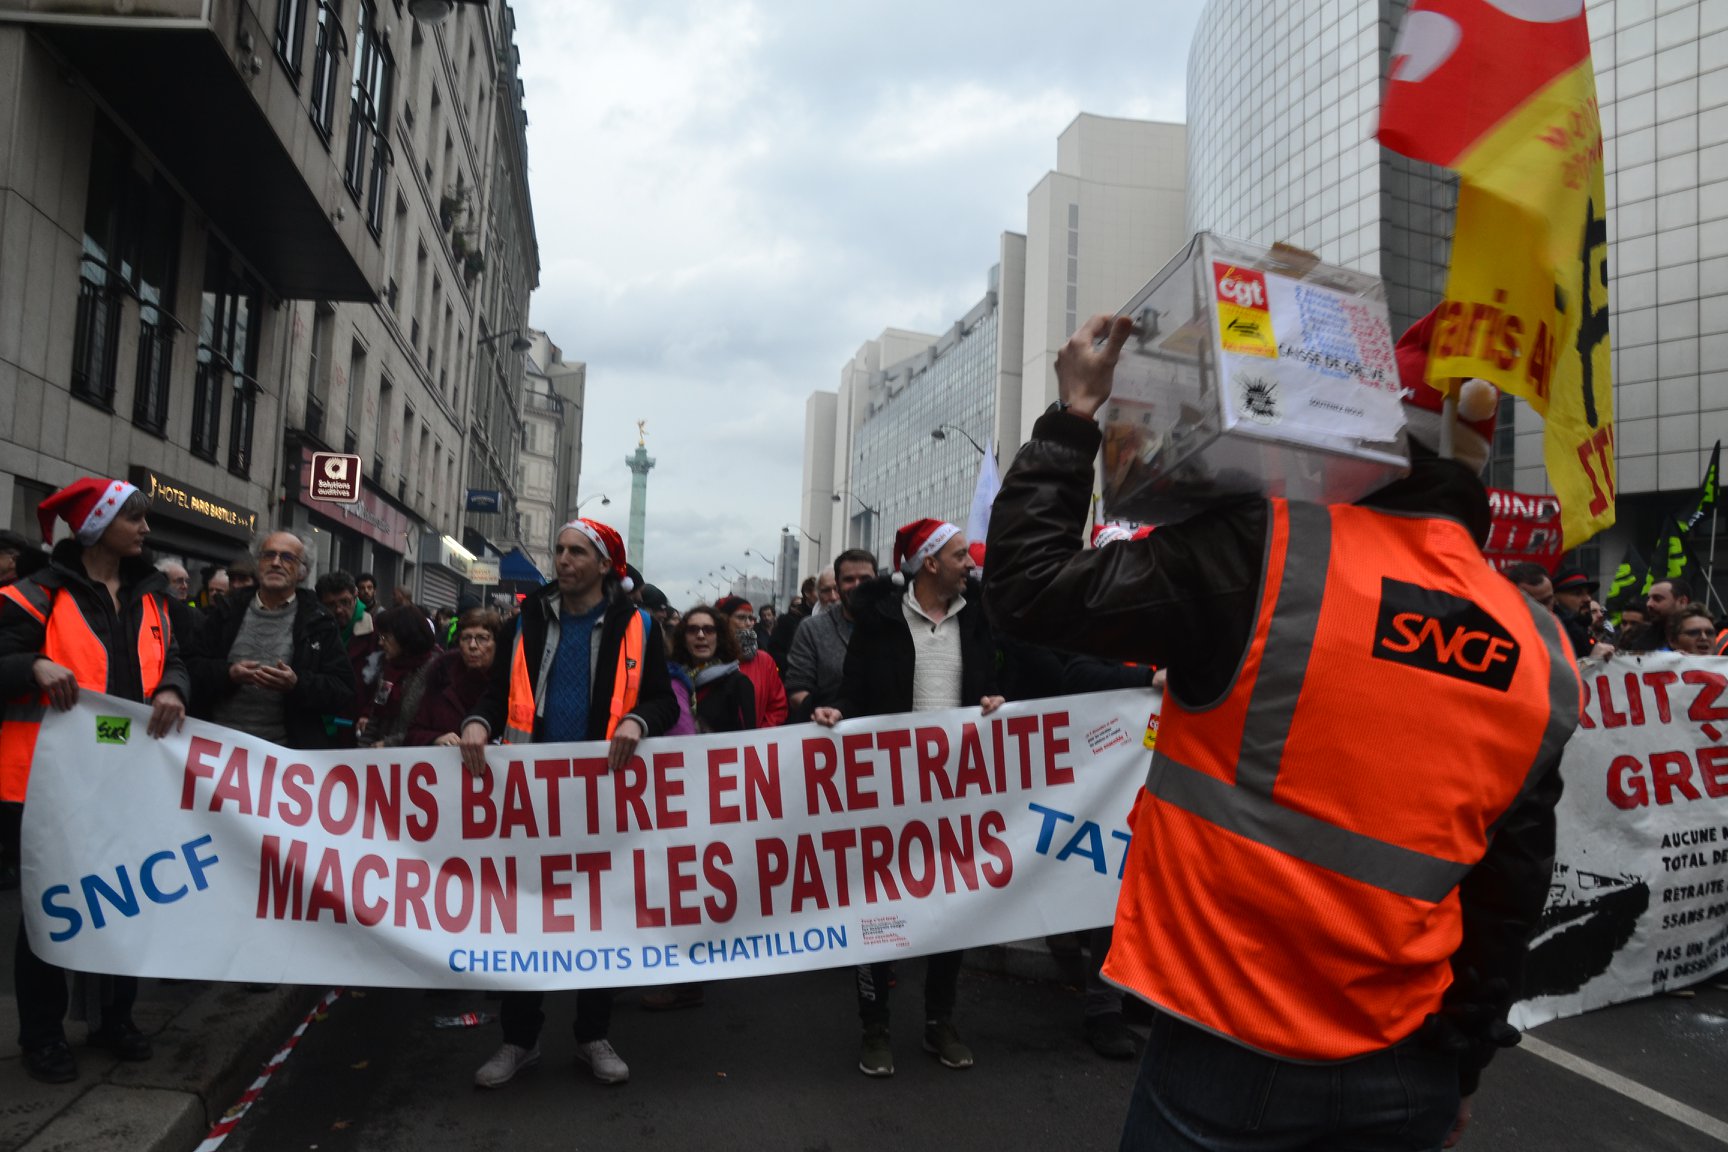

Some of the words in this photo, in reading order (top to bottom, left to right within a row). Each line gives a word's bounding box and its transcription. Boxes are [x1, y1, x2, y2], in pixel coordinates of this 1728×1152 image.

[1219, 278, 1264, 308] cgt
[318, 479, 351, 490] Solutions
[158, 482, 189, 509] HOTEL
[190, 496, 210, 516] PARIS
[210, 503, 237, 525] BASTILLE
[1381, 612, 1514, 673] SNCF
[180, 736, 439, 842] FAISONS
[461, 751, 688, 840] BATTRE
[707, 742, 783, 825] EN
[801, 711, 1075, 816] RETRAITE
[1661, 828, 1717, 848] AUCUNE
[256, 835, 518, 934] MACRON
[540, 851, 612, 933] ET
[632, 841, 738, 928] LES
[755, 809, 1014, 917] PATRONS
[1662, 852, 1708, 872] TOTAL
[41, 834, 220, 943] SNCF
[1663, 879, 1724, 903] RETRAITE
[448, 946, 632, 973] CHEMINOTS
[642, 944, 679, 969] DE
[688, 924, 848, 966] CHATILLON
[1656, 946, 1682, 964] PAS
[1686, 941, 1703, 957] UN
[1652, 968, 1669, 985] EN
